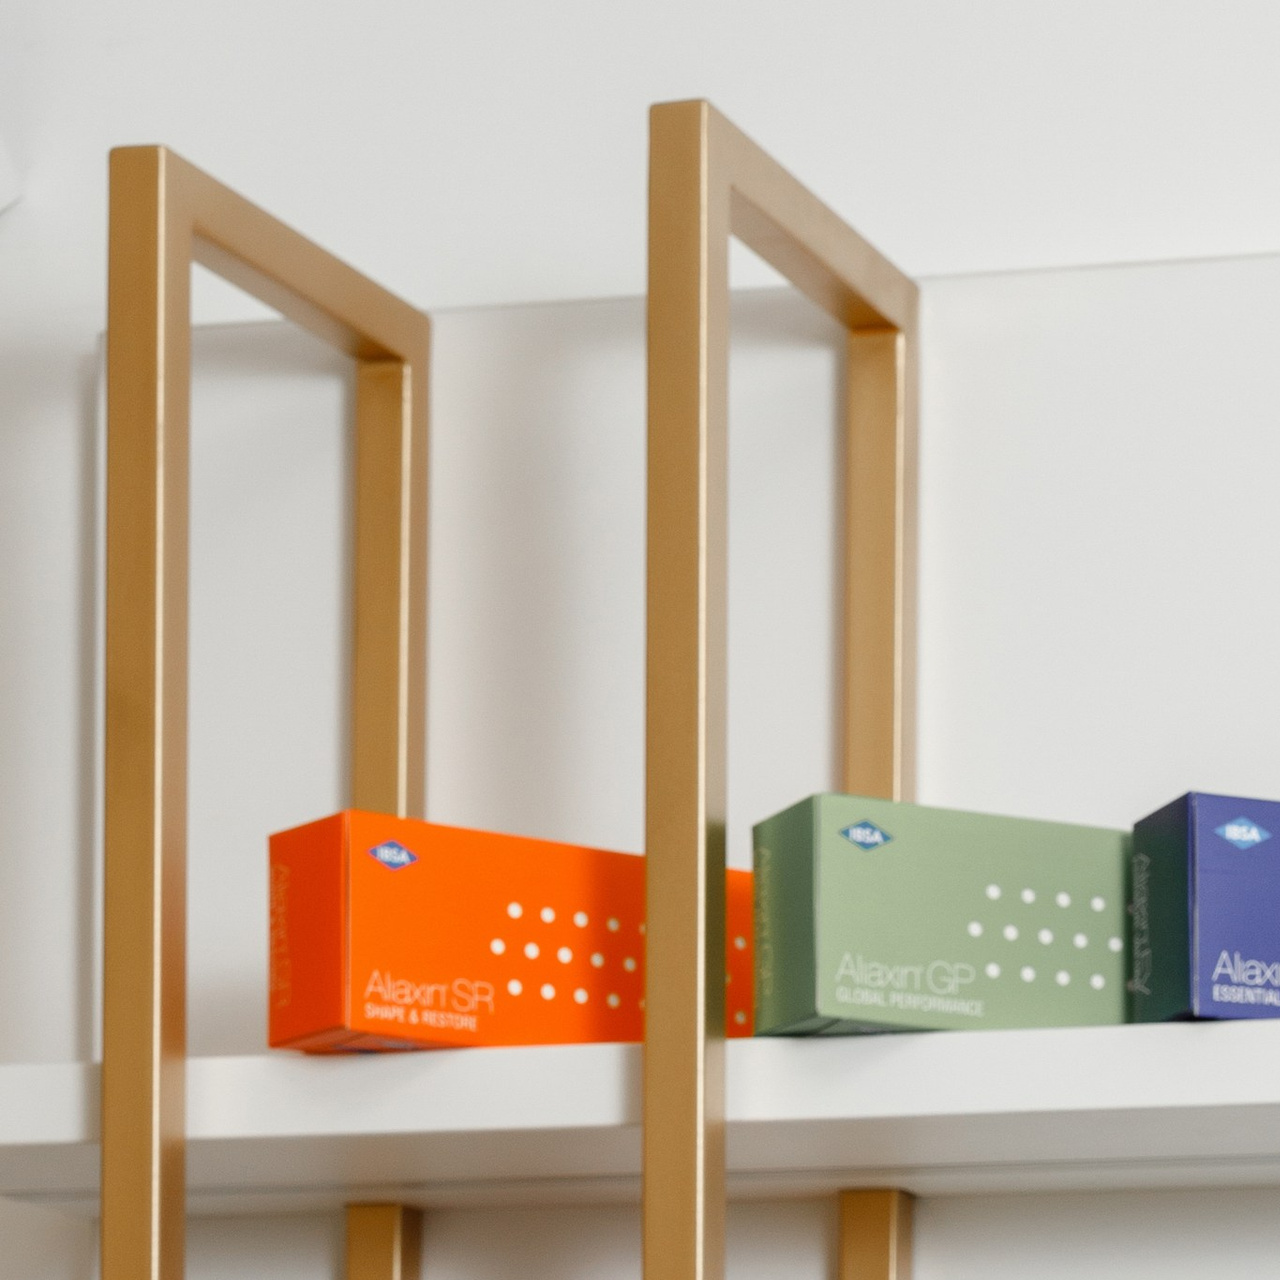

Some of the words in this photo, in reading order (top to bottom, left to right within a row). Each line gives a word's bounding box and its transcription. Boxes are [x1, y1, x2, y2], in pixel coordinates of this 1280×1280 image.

[848, 826, 885, 845] IBSA
[1225, 825, 1262, 842] IBSA
[376, 846, 410, 865] IBSA
[926, 959, 977, 995] GP
[451, 977, 495, 1015] SR
